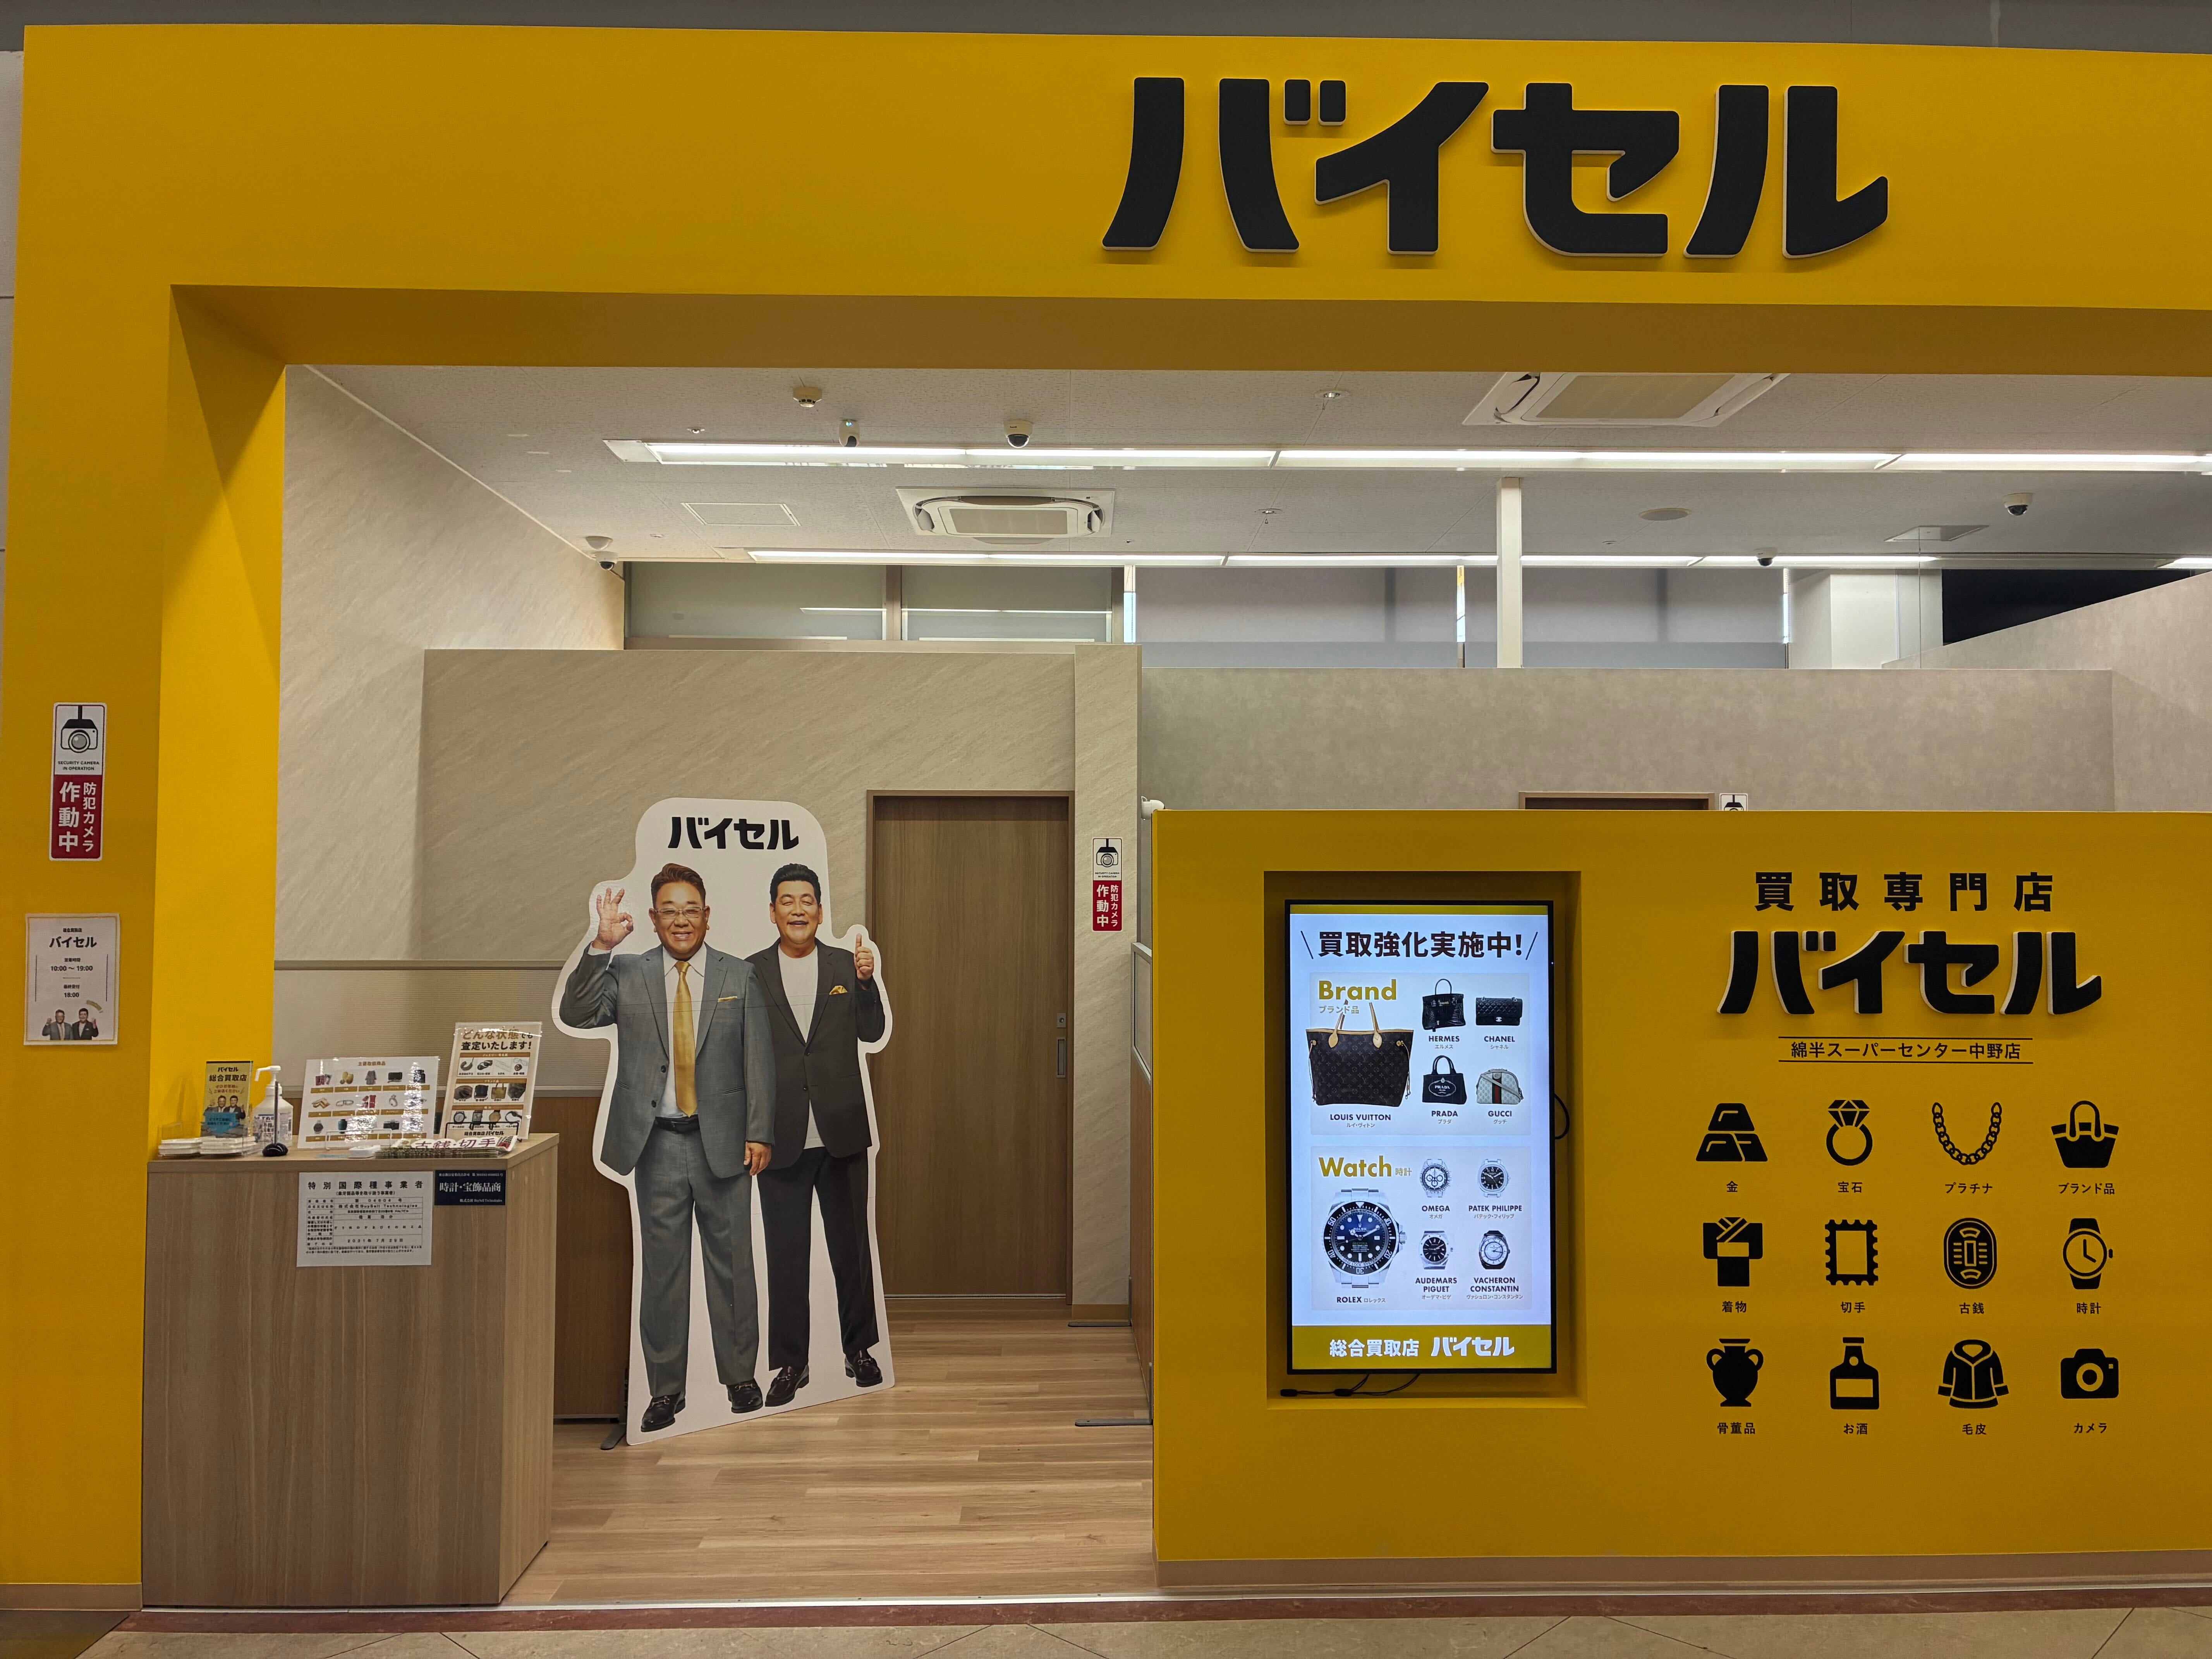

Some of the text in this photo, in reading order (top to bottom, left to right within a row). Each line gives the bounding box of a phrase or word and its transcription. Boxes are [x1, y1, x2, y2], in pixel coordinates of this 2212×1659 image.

[1103, 77, 1888, 258] バイセル
[58, 782, 80, 853] 作動中
[83, 782, 96, 852] 防犯カメラ
[668, 817, 799, 850] バイセル
[1755, 872, 2053, 912] 買取専門店
[1097, 884, 1109, 927] 作動中
[49, 936, 97, 948] バイセル
[1318, 931, 1522, 958] 買取強化実施中!
[1717, 931, 2102, 1015] バイセル
[1319, 979, 1396, 1000] Brand
[1319, 1006, 1359, 1014] ブランド品
[461, 1041, 531, 1050] 査定いたします!
[1791, 1042, 2020, 1060] 綿半スーパーセンター中野店
[1318, 1156, 1412, 1177] Watch 時計
[308, 1181, 423, 1190] 特別国際種事業者
[440, 1182, 501, 1192] 時計・宝飾品商
[1726, 1181, 1739, 1193] 金
[1837, 1181, 1862, 1193] 宝石
[1945, 1182, 1993, 1195] プラチナ
[2058, 1183, 2115, 1195] ブランド品
[1722, 1301, 1747, 1313] 着物
[1840, 1301, 1865, 1314] 切手
[1959, 1301, 1984, 1314] 古銭
[2076, 1302, 2101, 1314] 時計
[1329, 1337, 1515, 1357] 総合買取店 バイセル
[1717, 1422, 1756, 1435] 骨董品
[1843, 1422, 1869, 1435] お酒
[1962, 1423, 1987, 1435] 毛皮
[2074, 1422, 2107, 1434] カメラ
